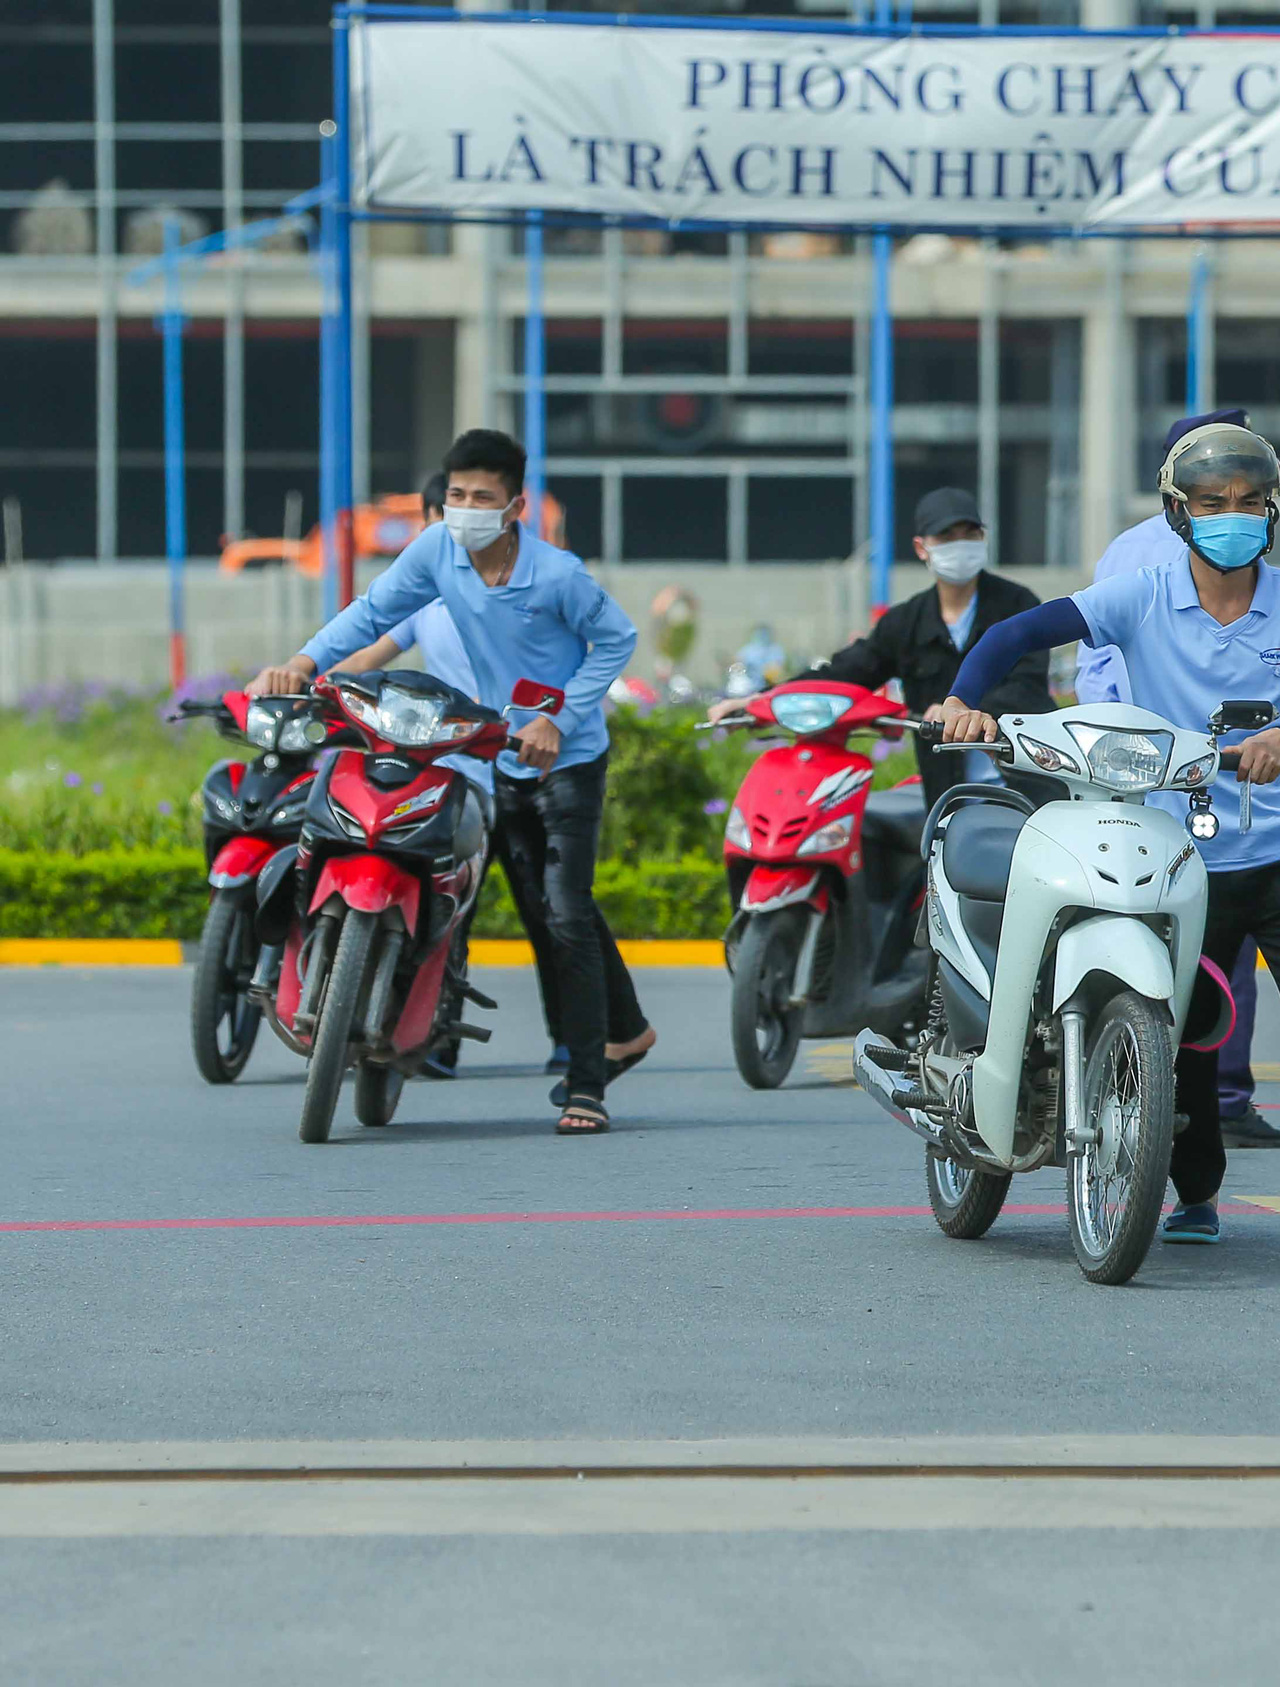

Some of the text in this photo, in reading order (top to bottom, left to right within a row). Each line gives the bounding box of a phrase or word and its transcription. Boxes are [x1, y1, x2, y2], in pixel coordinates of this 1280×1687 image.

[687, 47, 966, 114] PHÒNG
[994, 48, 1203, 117] CHÁY
[451, 114, 546, 183] LÀ
[570, 126, 837, 198] TRÁCH
[870, 132, 1129, 213] NHIỆM
[1097, 819, 1143, 828] HONDA
